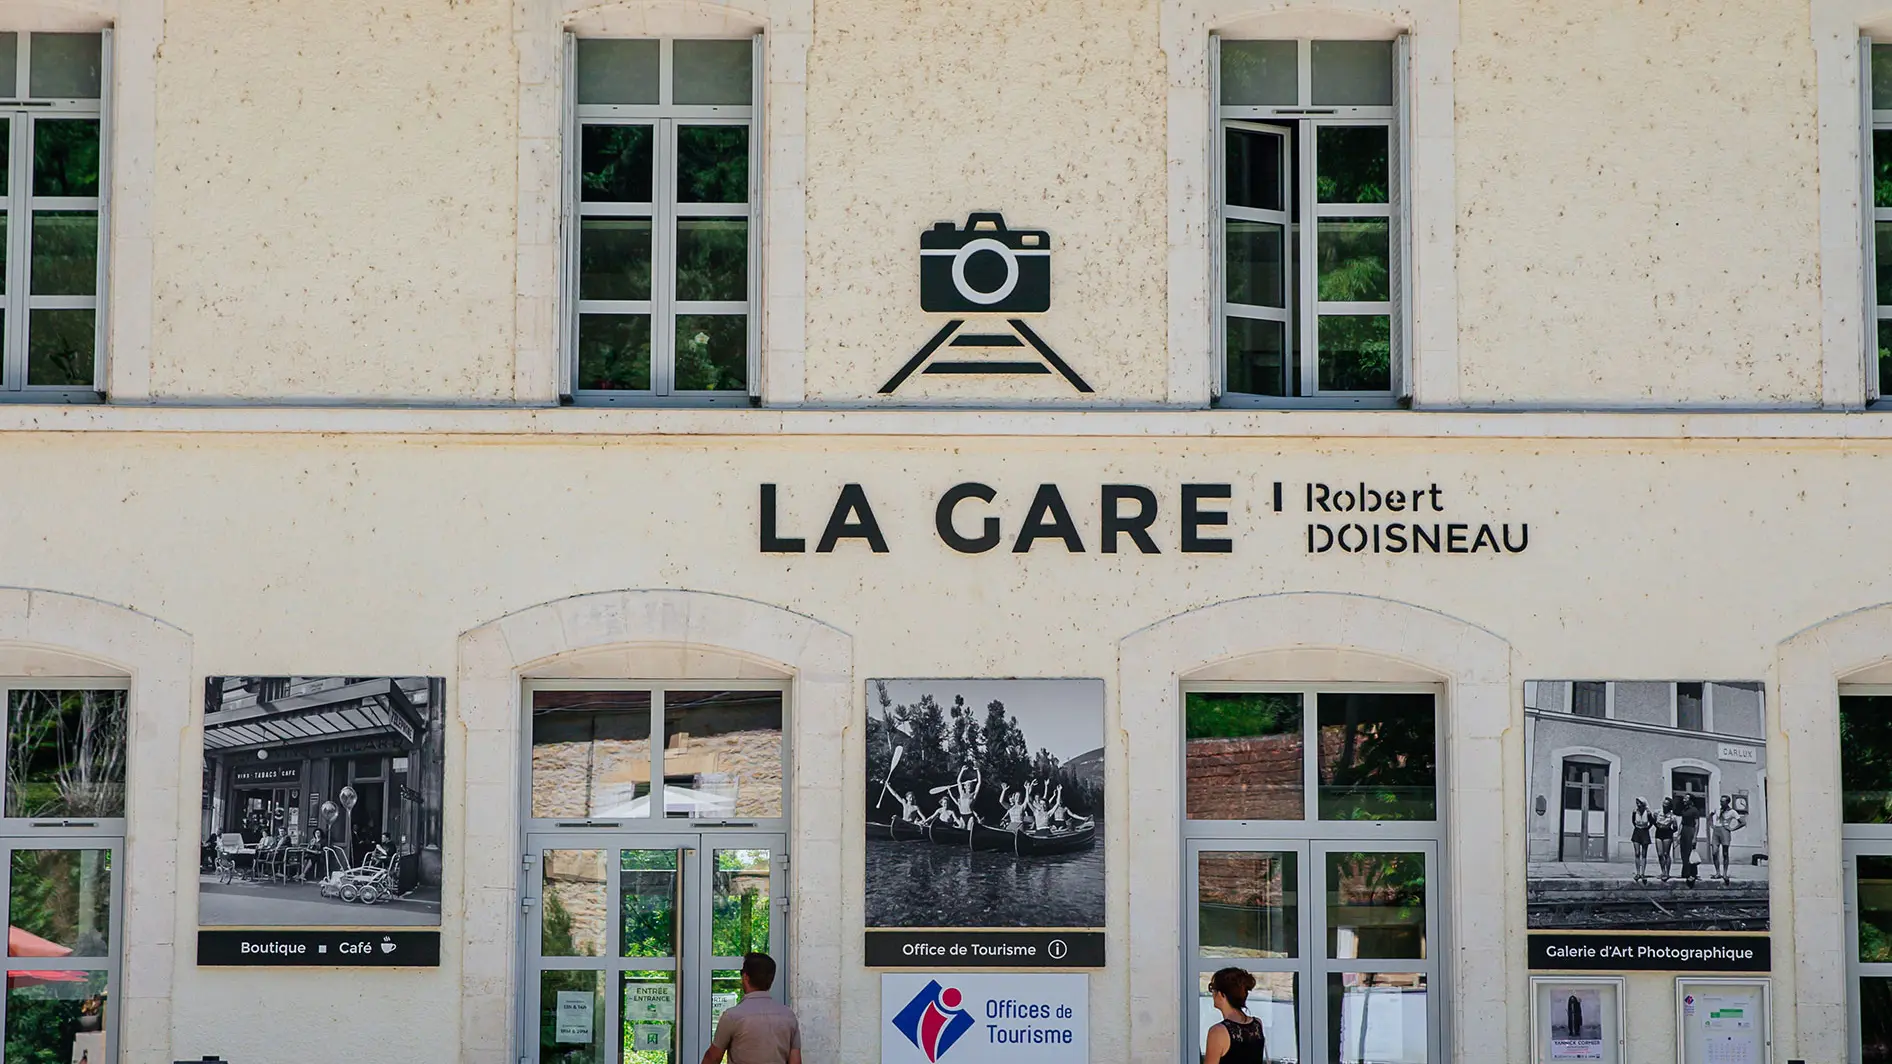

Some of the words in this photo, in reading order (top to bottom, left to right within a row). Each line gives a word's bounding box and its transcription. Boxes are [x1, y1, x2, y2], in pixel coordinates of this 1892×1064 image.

[1307, 482, 1443, 512] Robert
[760, 483, 889, 554] LA
[935, 482, 1233, 554] GARE
[1308, 523, 1528, 554] DOISNEAU
[1722, 748, 1753, 758] CARLUX
[254, 770, 277, 779] TABACS
[241, 941, 306, 957] Boutique
[339, 940, 372, 954] Café
[902, 943, 946, 956] Office
[949, 943, 968, 956] de
[971, 943, 1037, 956] Tourisme
[1546, 945, 1596, 958] Galerie
[1600, 946, 1634, 958] d'Art
[1638, 946, 1754, 962] Photographique
[636, 987, 668, 995] ENTRÉE
[986, 999, 1050, 1019] Offices
[1056, 1004, 1073, 1019] de
[986, 1024, 1073, 1044] Tourisme
